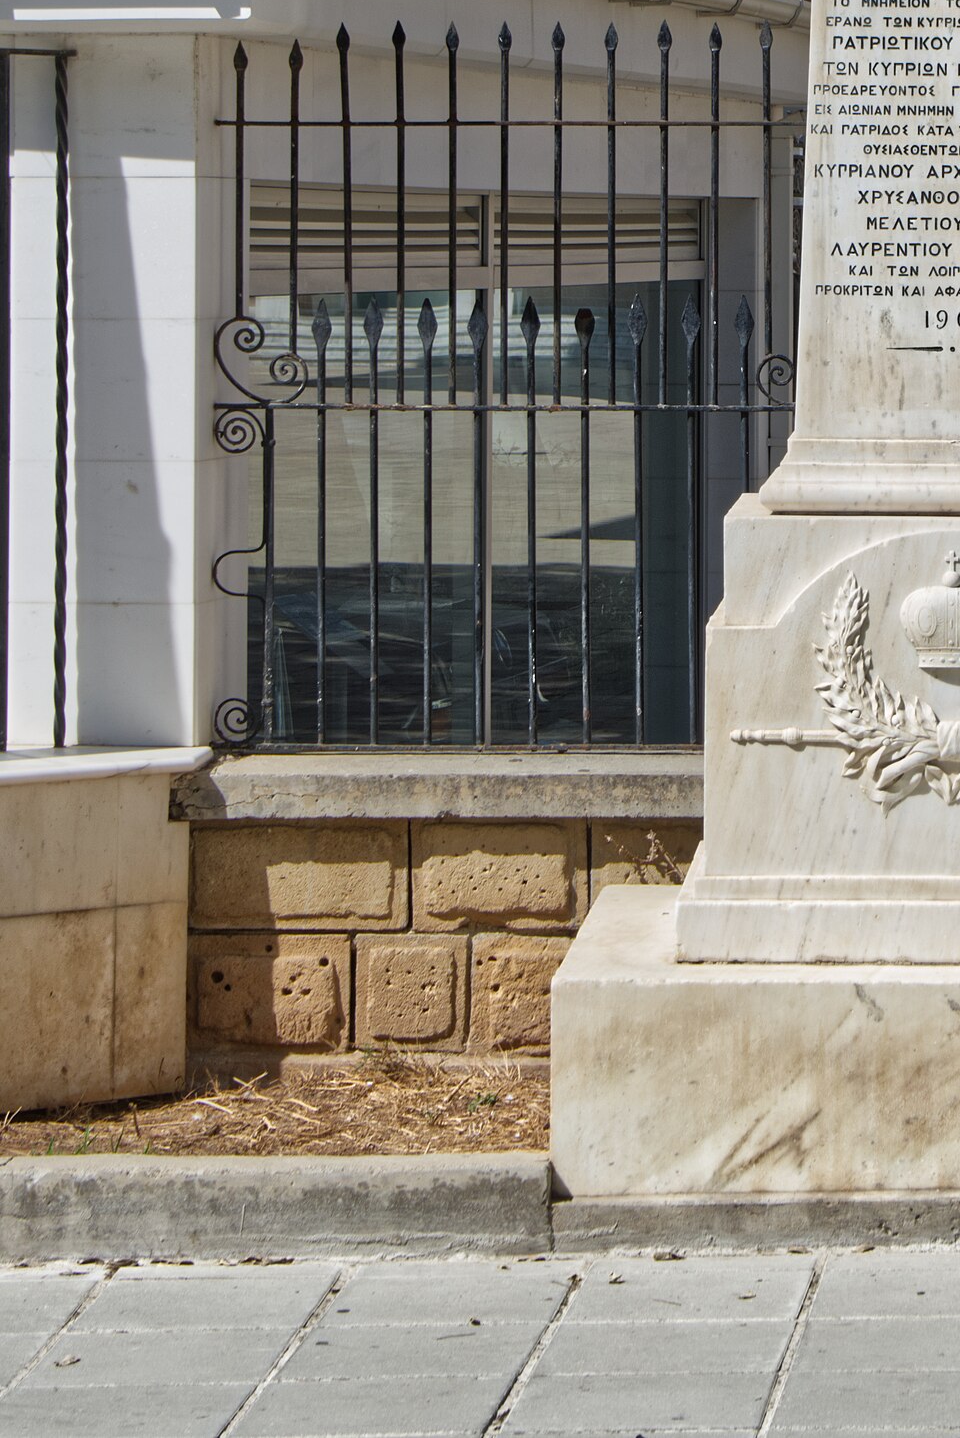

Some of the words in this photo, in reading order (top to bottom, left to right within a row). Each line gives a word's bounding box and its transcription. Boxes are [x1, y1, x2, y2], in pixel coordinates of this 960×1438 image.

[826, 17, 872, 27] ΕΡΑΝΩ
[883, 17, 912, 27] ΤΩΝ
[833, 36, 953, 50] ΠΑΤΡΙΩΤΙΚΟΥ
[823, 62, 858, 76] ΤΩΝ
[869, 62, 947, 77] ΚΥΠΡΙΩΝ
[814, 85, 935, 96] ΠΡΟΕΔΡΕΥΟΝΤΟΣ
[815, 104, 832, 115] ΕΙΣ
[838, 104, 891, 115] ΑΙΩΝΙΑΝ
[897, 105, 954, 116] ΜΝΗΜΗΝ
[811, 124, 832, 135] ΚΑΙ
[842, 124, 908, 136] ΠΑΤΡΙΔΟΣ
[918, 125, 954, 136] ΚΑΤΑ
[814, 164, 914, 178] ΚΥΠΡΙΑΝΟΥ
[831, 242, 952, 257] ΛΑΥΡΕΝΤΙΟΥ
[849, 265, 872, 276] ΚΑΙ
[887, 266, 919, 276] ΤΩΝ
[815, 285, 893, 296] ΠΡΟΚΡΙΤΩΝ
[902, 286, 925, 296] ΚΑΙ
